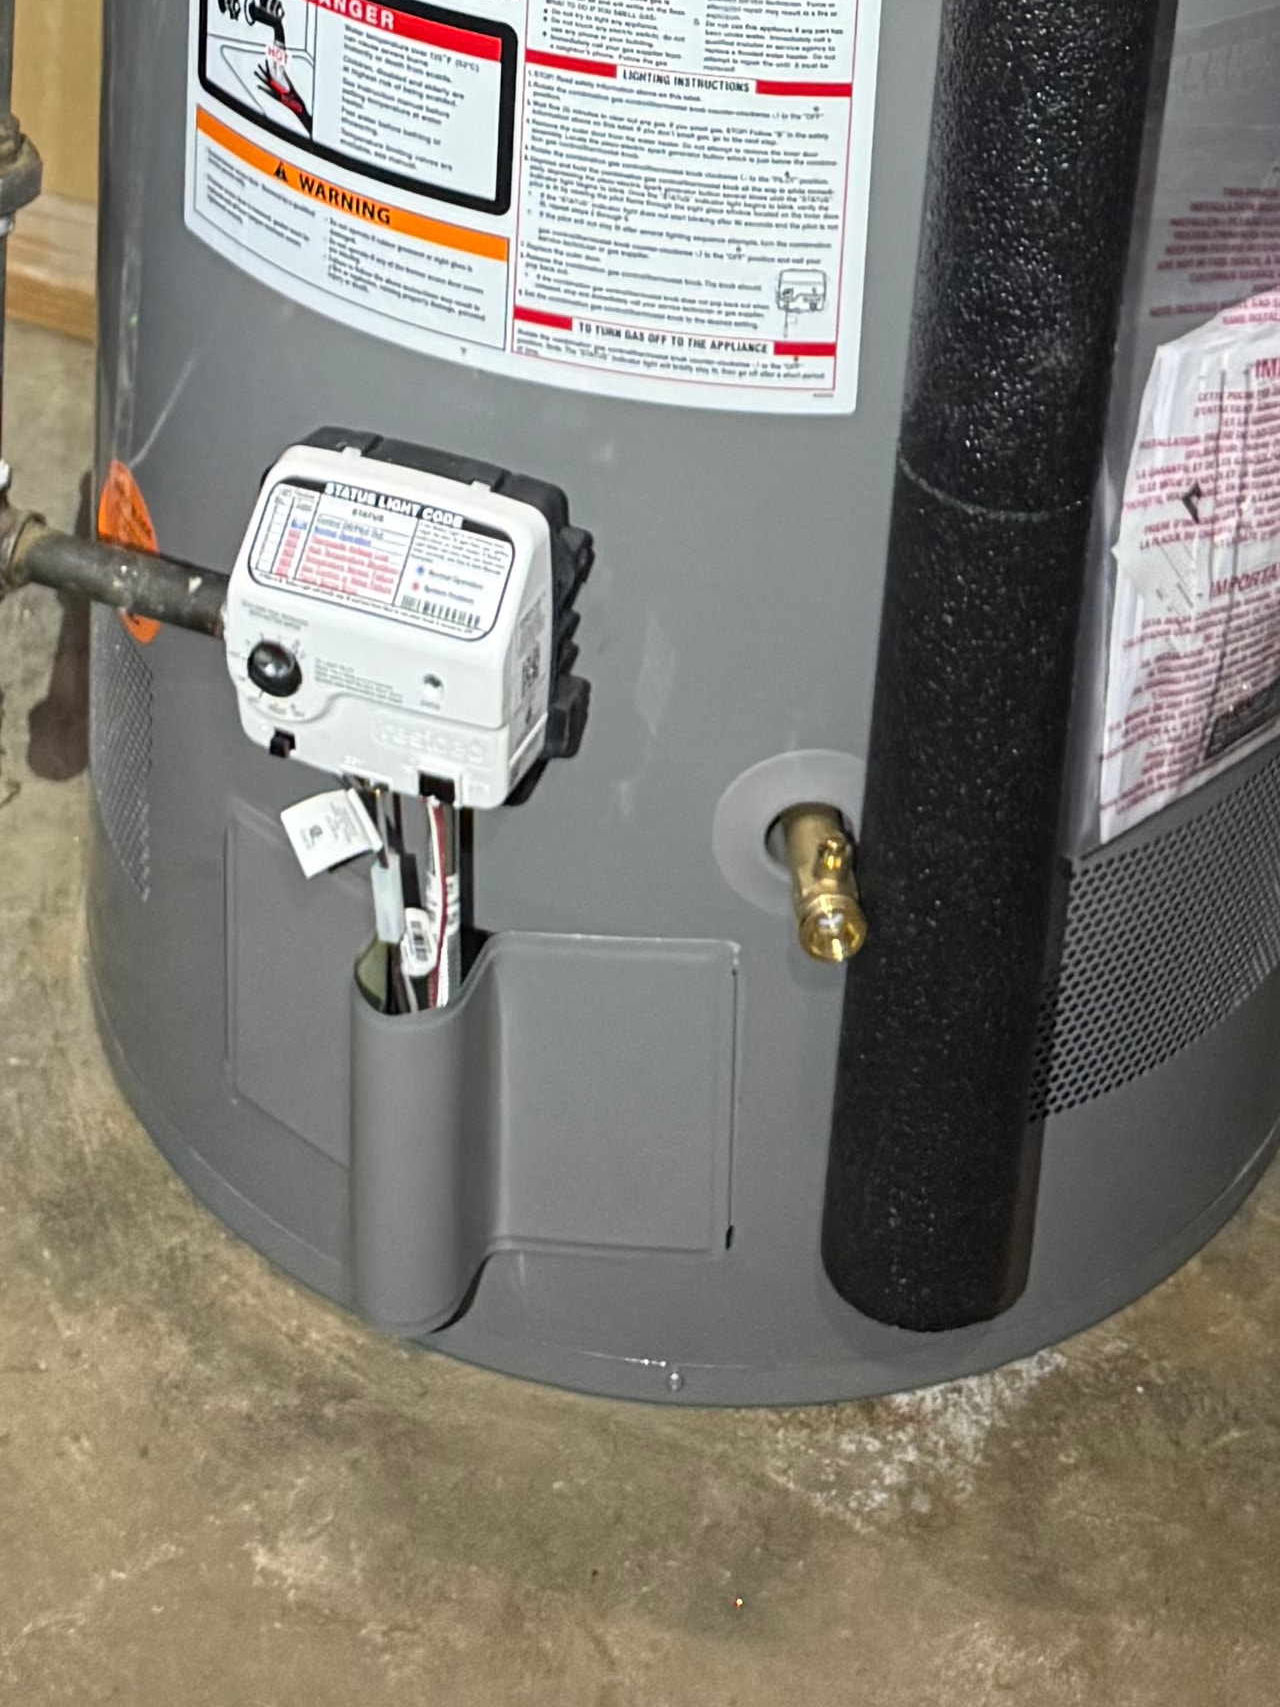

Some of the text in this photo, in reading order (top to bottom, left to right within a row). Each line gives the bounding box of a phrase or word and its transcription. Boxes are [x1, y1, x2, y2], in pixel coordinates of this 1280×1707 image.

[267, 45, 290, 64] HOT
[623, 70, 749, 93] LIGHTING INSTRUCTIONS
[298, 172, 392, 226] WARNING
[579, 322, 767, 353] TO TURN GAS OFF TO THE APPLIANCE
[325, 482, 464, 528] STATUS LIGHT CODE
